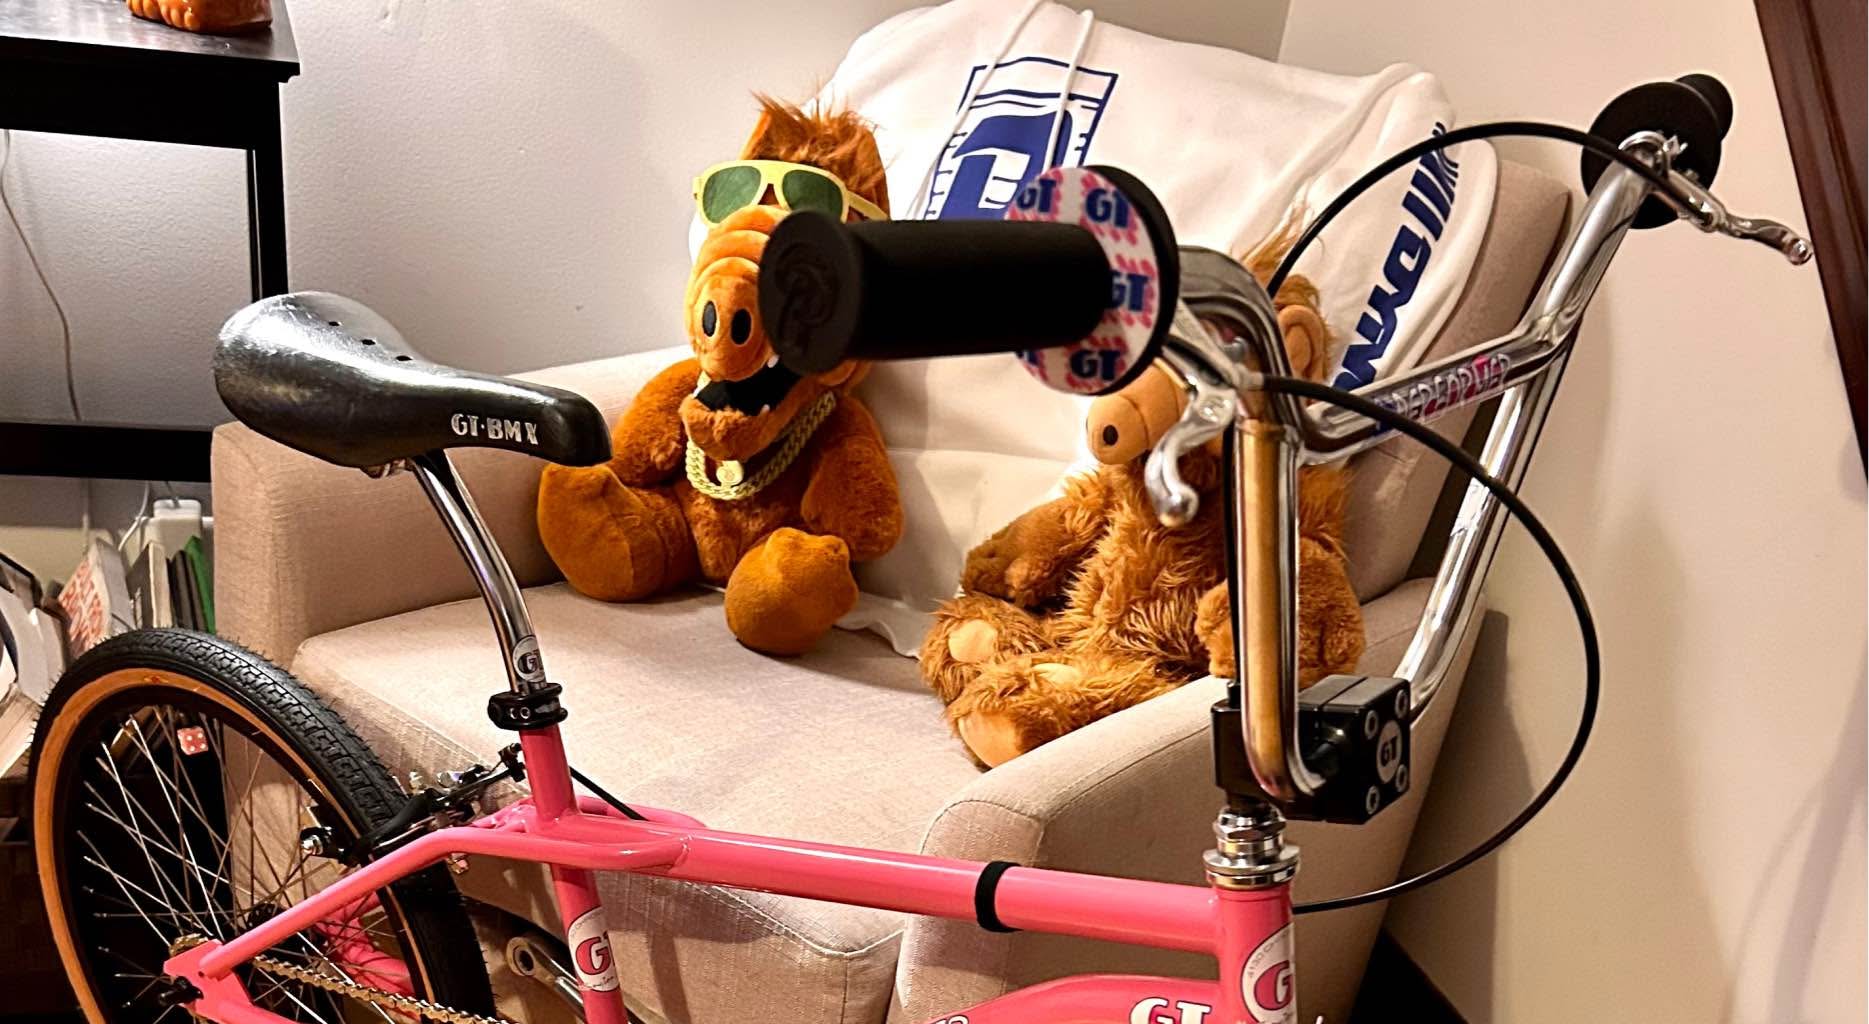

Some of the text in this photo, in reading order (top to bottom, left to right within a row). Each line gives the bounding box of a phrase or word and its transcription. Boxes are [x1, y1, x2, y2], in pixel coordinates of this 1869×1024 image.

[1016, 177, 1058, 214] GT
[1084, 187, 1130, 229] GT
[1070, 349, 1122, 381] GT
[1380, 735, 1398, 767] GT
